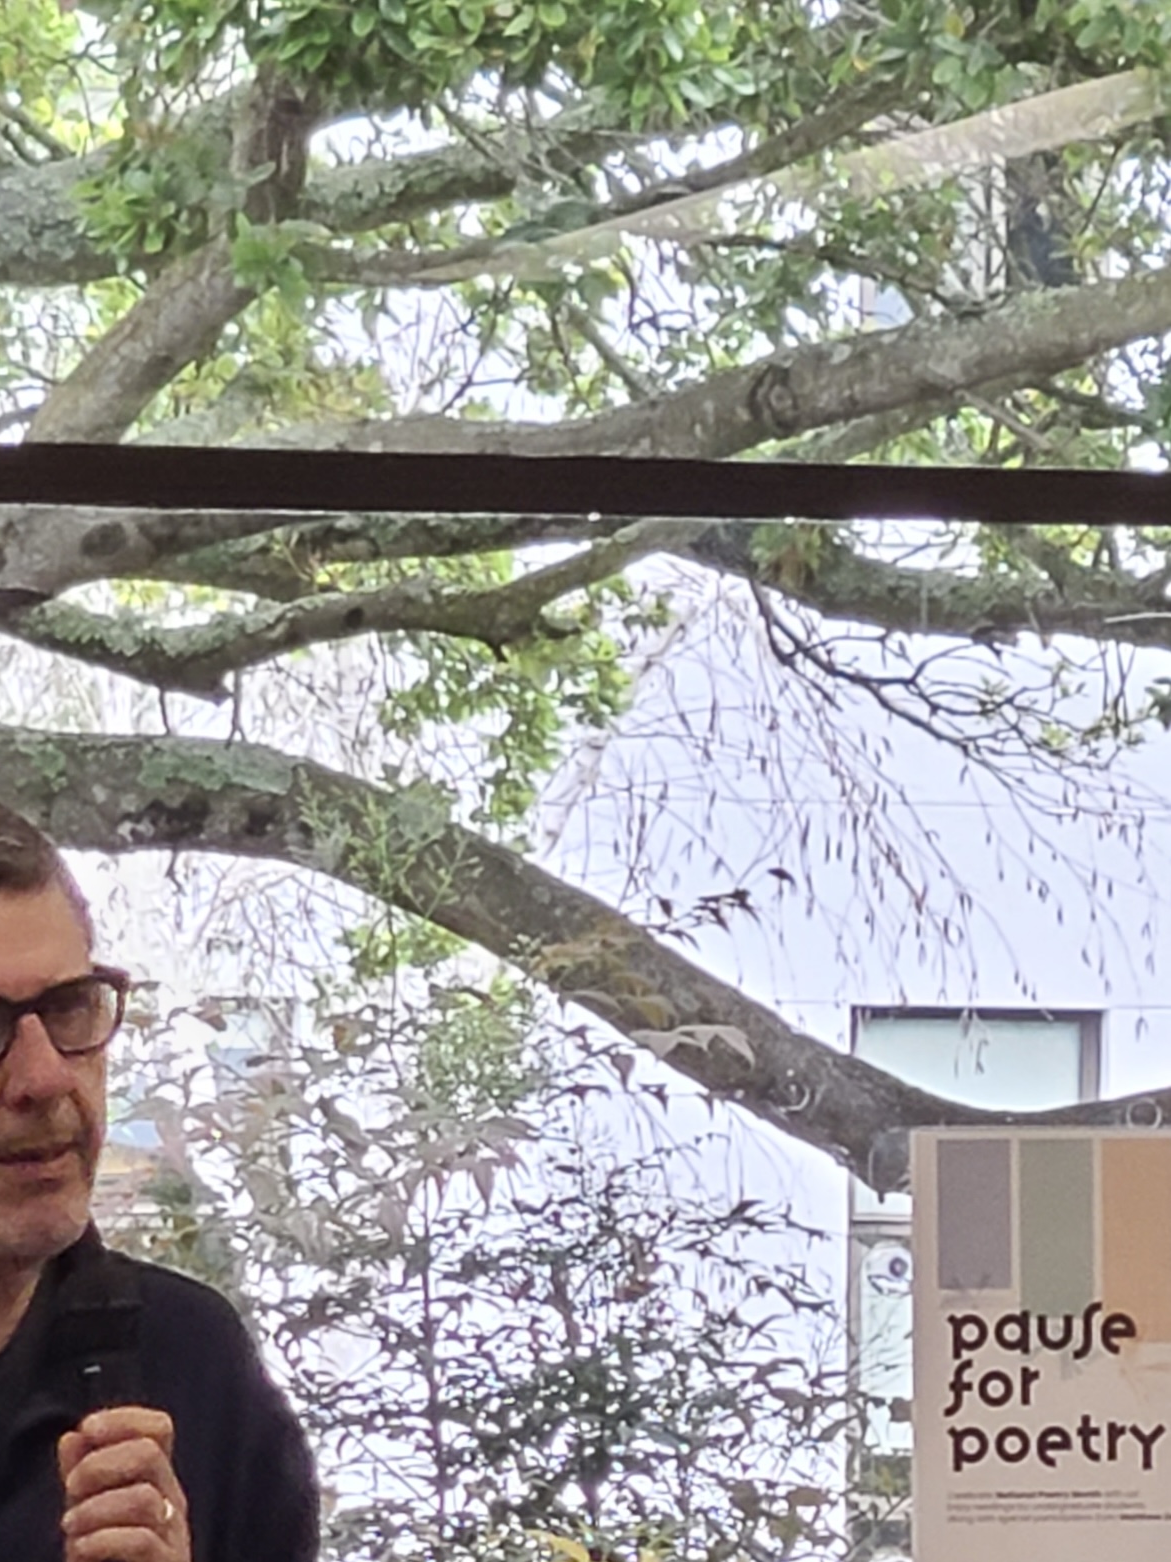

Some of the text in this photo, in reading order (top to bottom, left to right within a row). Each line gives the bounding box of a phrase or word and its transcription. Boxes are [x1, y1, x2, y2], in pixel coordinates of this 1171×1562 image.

[947, 1302, 1137, 1360] pause
[943, 1359, 1040, 1417] for
[947, 1414, 1166, 1472] poetry
